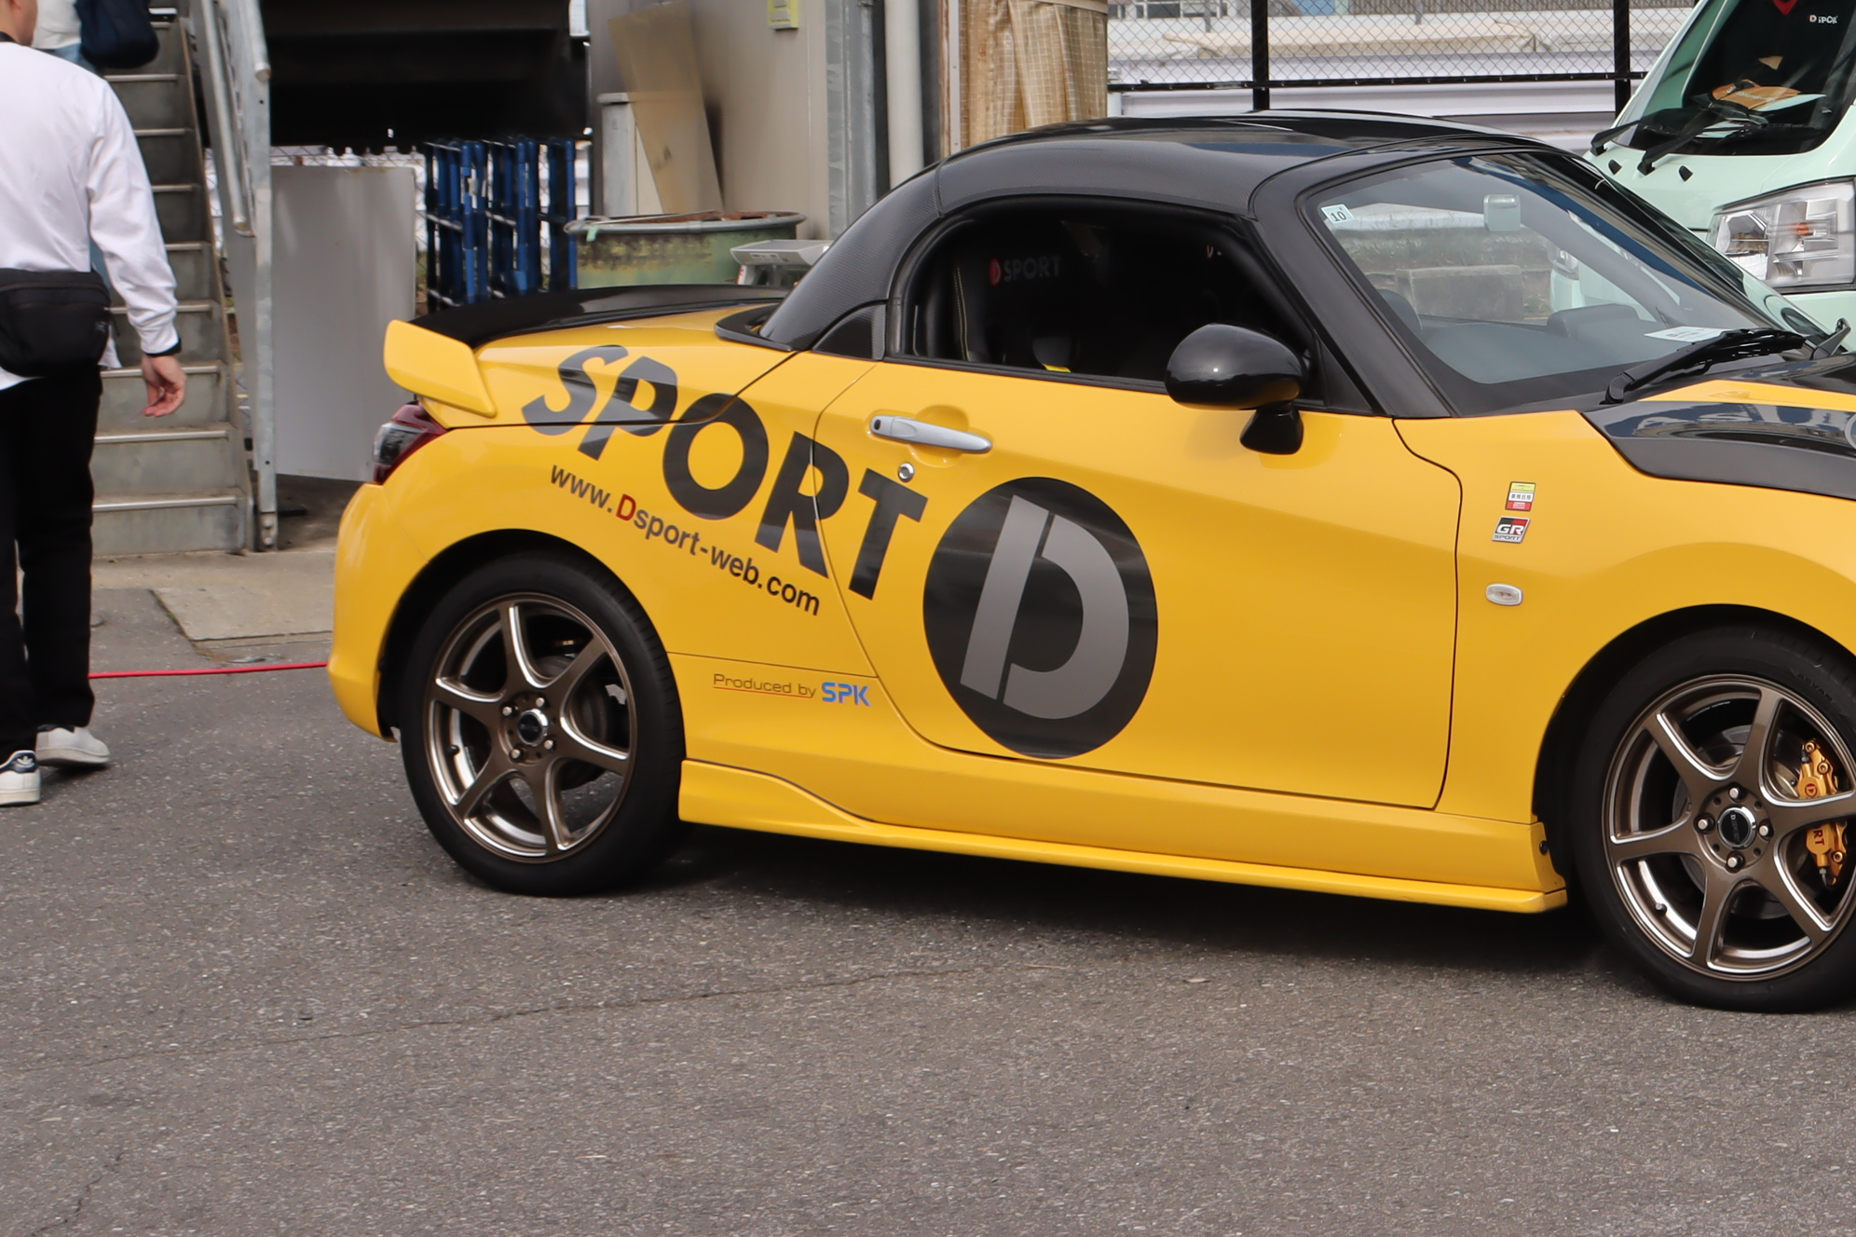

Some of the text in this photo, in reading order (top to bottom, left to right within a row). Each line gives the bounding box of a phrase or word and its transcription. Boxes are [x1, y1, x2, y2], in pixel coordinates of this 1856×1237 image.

[1330, 210, 1347, 222] 10
[1003, 255, 1062, 283] SPORT
[520, 344, 930, 602] SPORT
[549, 464, 821, 617] www.Dsport-web.com
[1496, 524, 1526, 536] GR
[958, 493, 1132, 722] D
[712, 672, 872, 708] Produced by SPK
